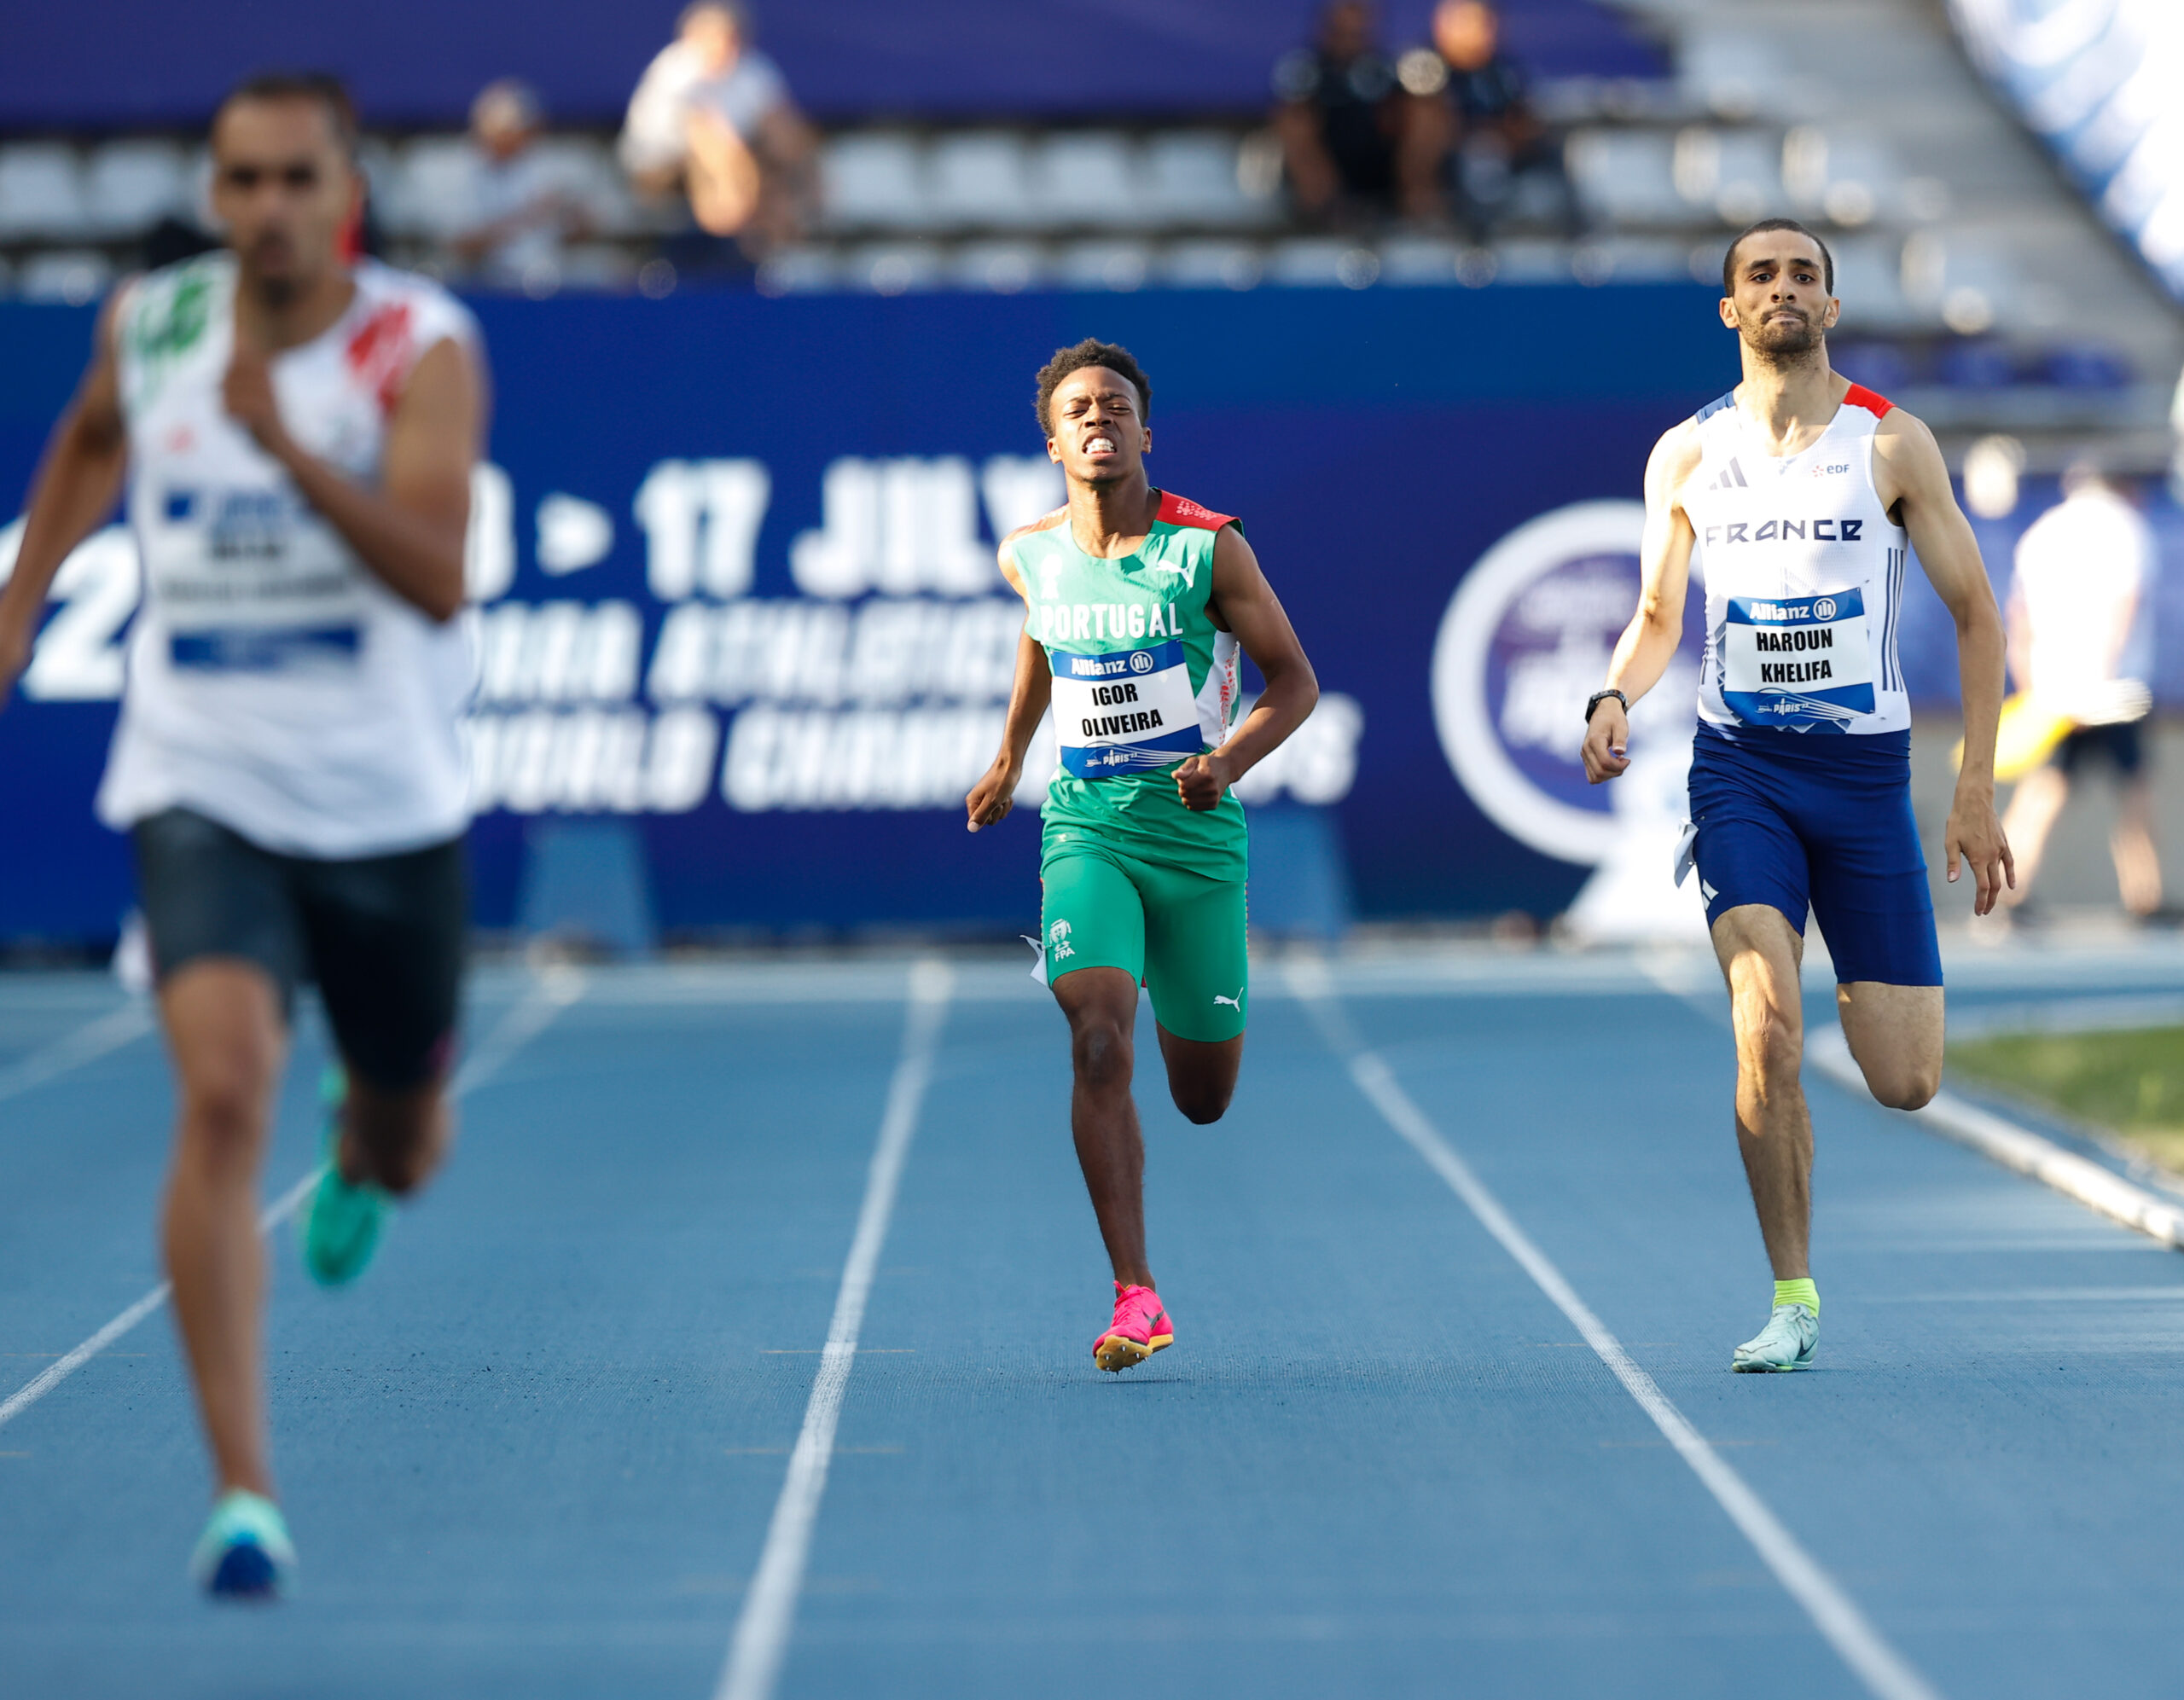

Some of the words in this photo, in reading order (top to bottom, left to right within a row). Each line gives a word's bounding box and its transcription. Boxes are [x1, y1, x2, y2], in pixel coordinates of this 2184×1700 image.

[1706, 519, 1862, 547] FRANCE
[1040, 602, 1183, 640] PORTUGAL
[1750, 602, 1809, 620] Allianz
[1756, 628, 1833, 652] HAROUN
[1072, 658, 1127, 676] Allianz
[1761, 659, 1833, 683] KHELIFA
[1092, 683, 1139, 706] IGOR
[1082, 709, 1163, 737] OLIVEIRA
[1054, 947, 1076, 962] FPA
